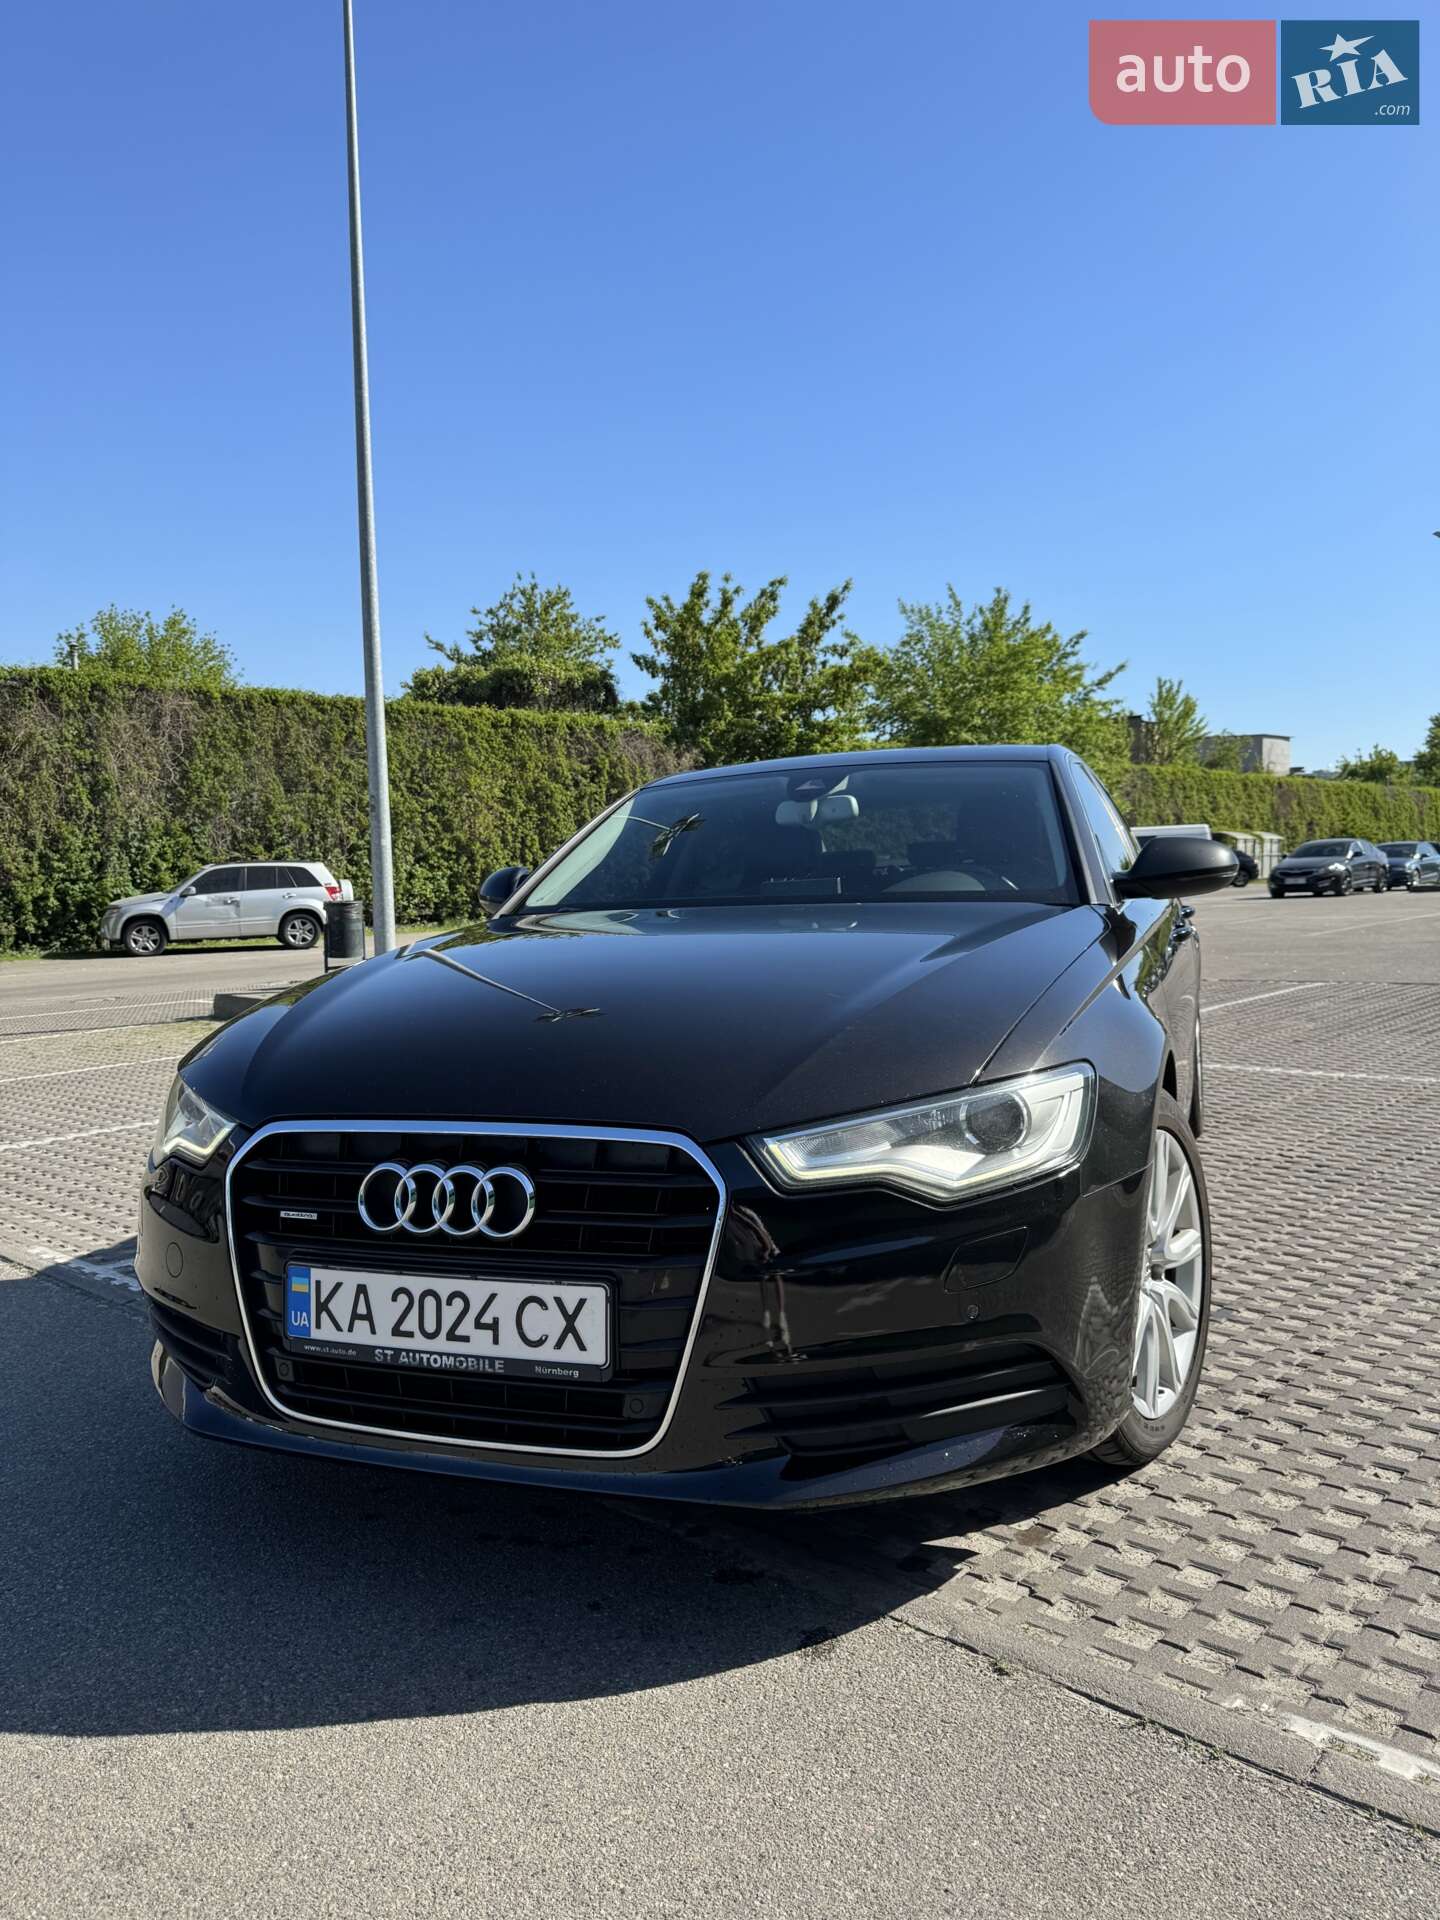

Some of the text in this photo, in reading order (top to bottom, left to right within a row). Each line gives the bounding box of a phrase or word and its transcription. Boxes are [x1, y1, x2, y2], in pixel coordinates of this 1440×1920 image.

[291, 1310, 309, 1327] UA
[315, 1280, 588, 1352] KA 2024 CX
[374, 1349, 505, 1373] ST AUTOMOBILE
[535, 1365, 580, 1378] Nürnberg
